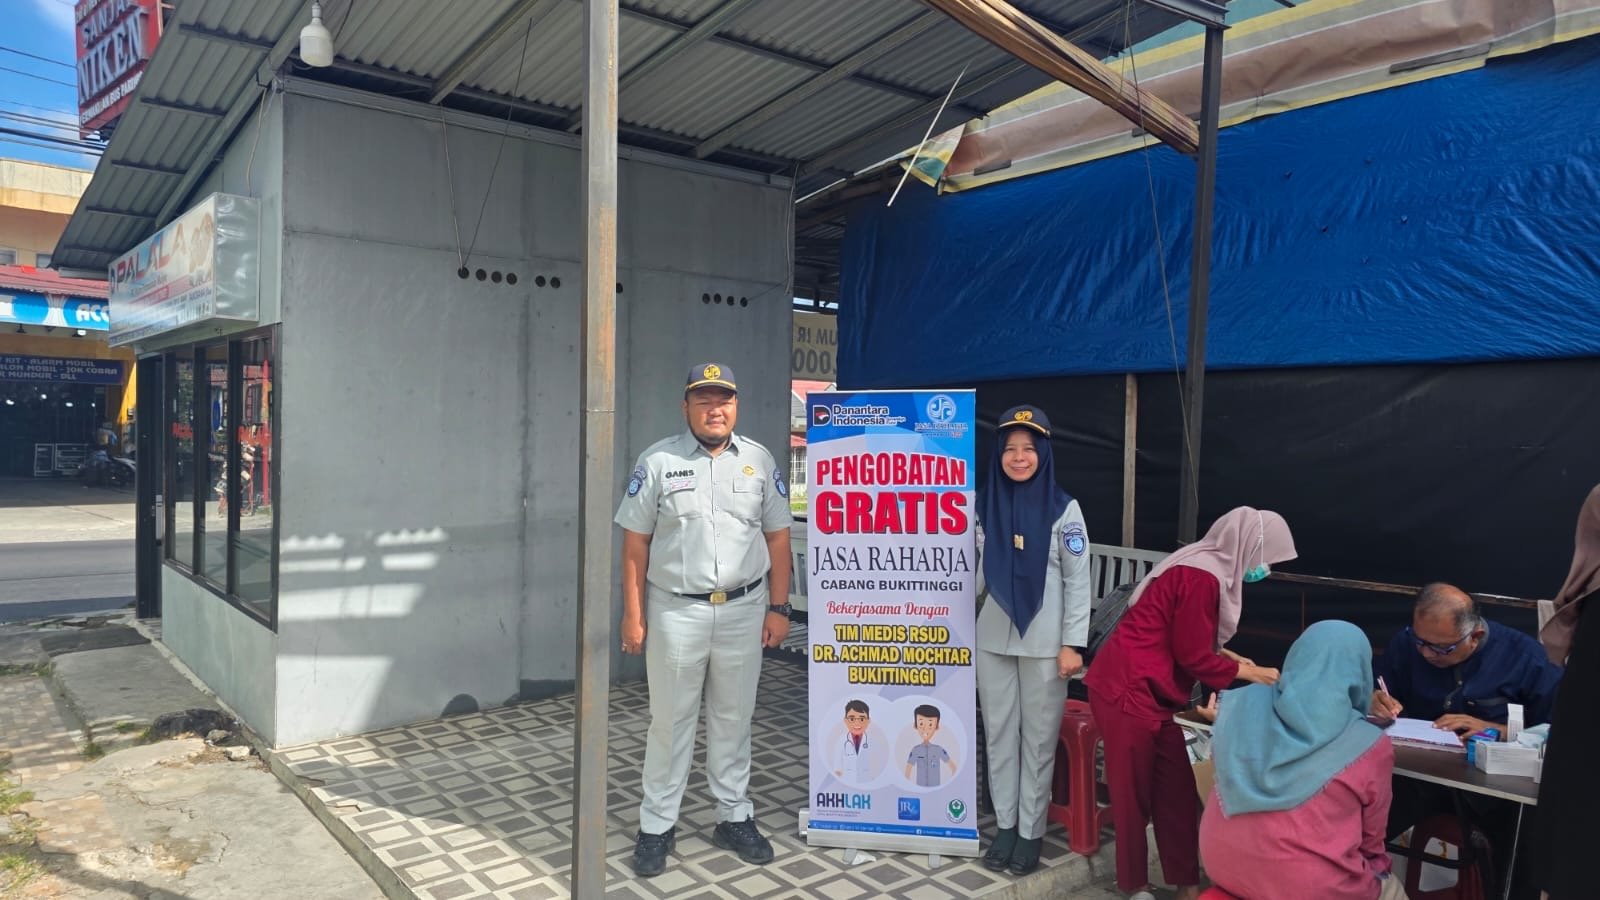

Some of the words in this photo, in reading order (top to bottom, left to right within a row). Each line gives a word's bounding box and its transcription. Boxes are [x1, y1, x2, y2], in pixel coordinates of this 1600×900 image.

[79, 7, 147, 105] NIKEN
[27, 365, 57, 373] MOBIL
[86, 367, 118, 375] COBRA
[66, 360, 96, 368] MOBIL
[833, 405, 889, 415] Danantara
[833, 416, 885, 426] Indonesia
[816, 453, 966, 486] PENGOBATAN
[815, 491, 968, 535] GRATIS
[813, 546, 861, 575] JASA
[867, 547, 970, 577] RAHARJA
[821, 580, 875, 590] CABANG
[879, 580, 963, 591] BUKITTINGGI
[827, 601, 901, 617] Bekerjasama
[904, 602, 949, 619] Dengan
[834, 624, 860, 642] TIM
[862, 625, 908, 643] MEDIS
[909, 625, 949, 643] RSUD
[813, 644, 838, 662] DR.
[840, 645, 900, 663] ACHMAD
[903, 647, 971, 666] MOCHTAR
[848, 666, 936, 686] BUKITTINGGI
[817, 793, 871, 809] AKHLAK
